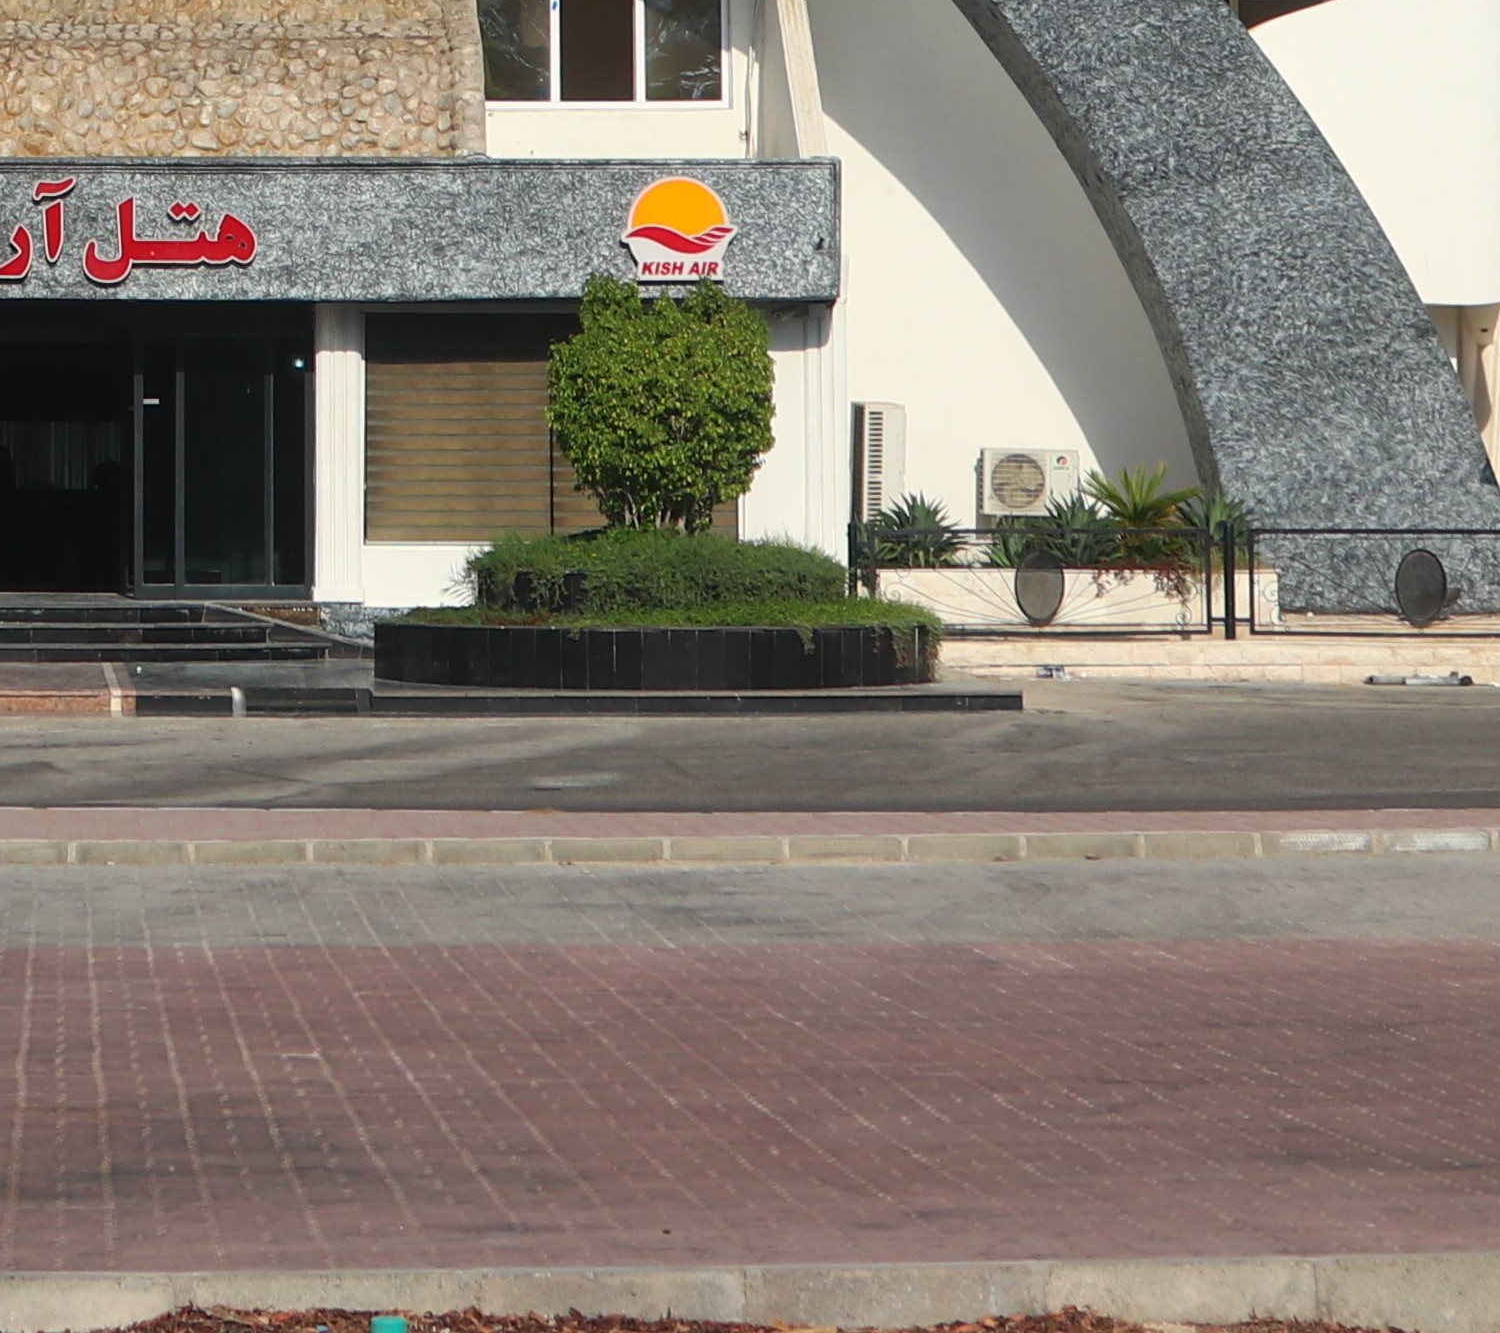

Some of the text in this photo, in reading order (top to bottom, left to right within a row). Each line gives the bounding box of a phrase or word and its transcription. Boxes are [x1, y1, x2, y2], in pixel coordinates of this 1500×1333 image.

[83, 196, 258, 284] هتل
[641, 261, 719, 276] KISH AIR
